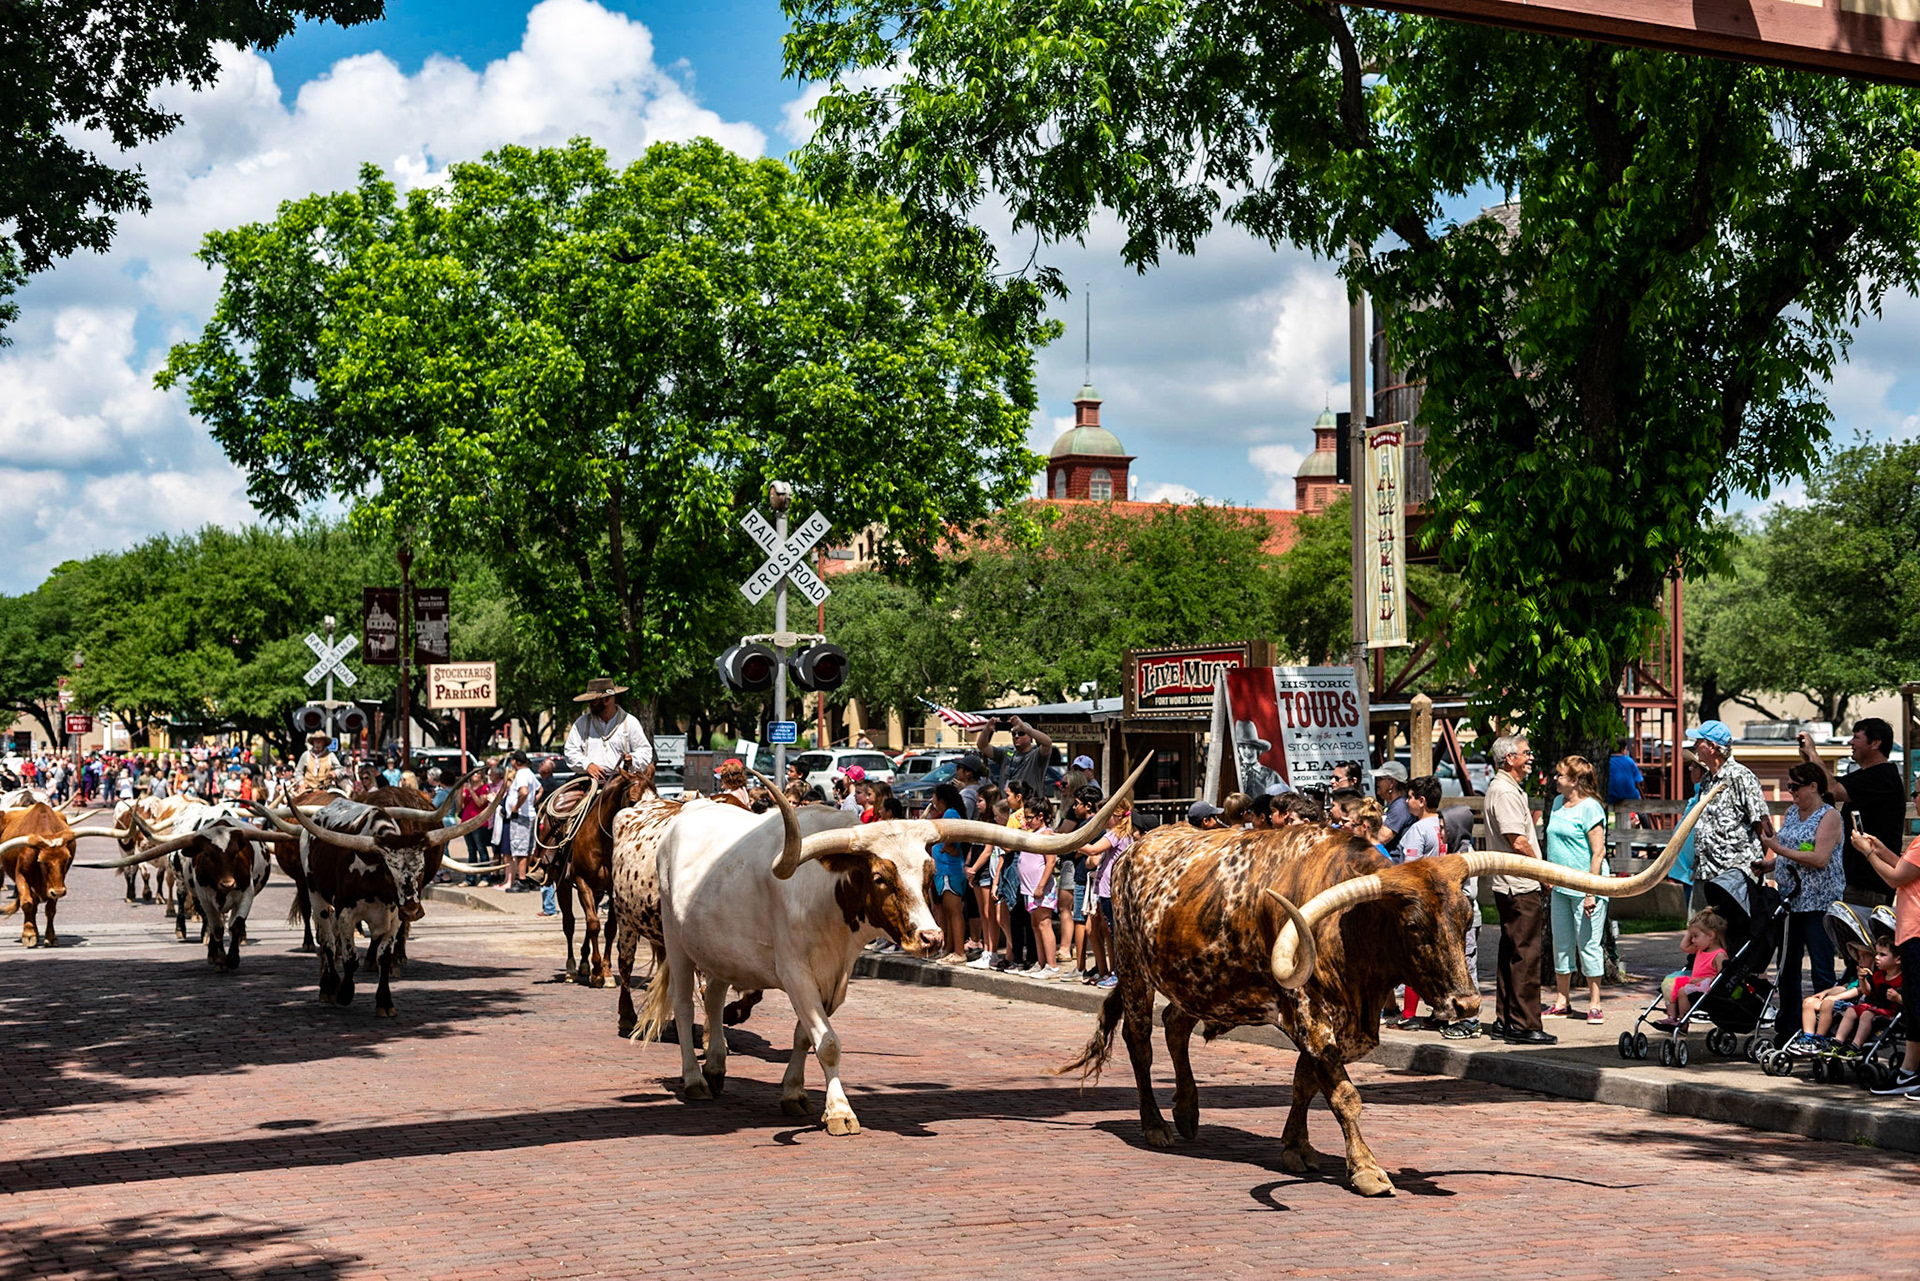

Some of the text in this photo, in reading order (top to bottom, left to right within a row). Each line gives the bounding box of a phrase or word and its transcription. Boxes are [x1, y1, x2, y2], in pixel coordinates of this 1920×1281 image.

[744, 513, 825, 601] RAIL ROAD
[748, 519, 824, 596] CROSSING
[307, 635, 355, 684] RAIL ROAD
[308, 638, 354, 682] CROSSING
[434, 666, 492, 682] STOCKYARDS
[1141, 658, 1239, 699] LIVE MUS
[435, 683, 491, 700] PARKING
[1280, 680, 1351, 689] HISTORIC
[1154, 694, 1214, 706] FORT WORTH STOCKYA
[1280, 690, 1360, 729] TOURS
[1038, 725, 1101, 735] MECHANICAL BULL
[1288, 741, 1364, 752] STOCKYARDS
[1292, 759, 1365, 772] LEAN
